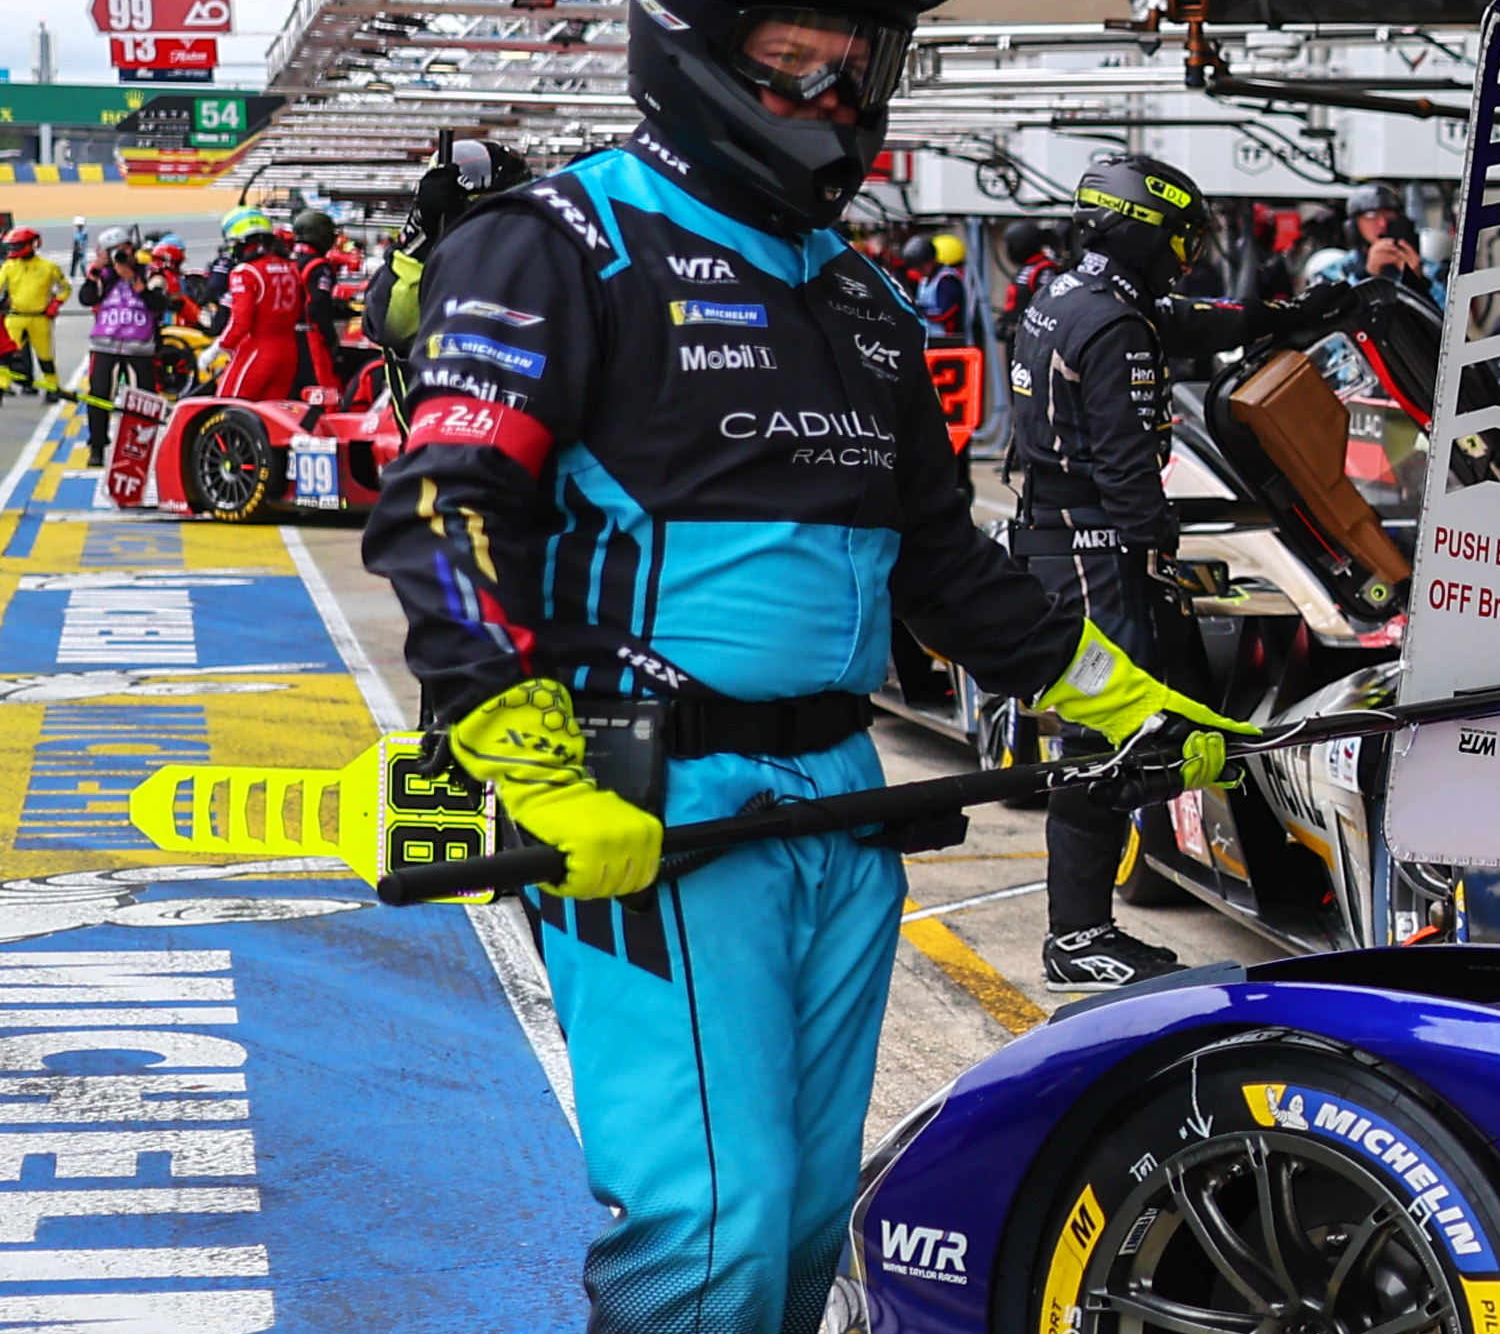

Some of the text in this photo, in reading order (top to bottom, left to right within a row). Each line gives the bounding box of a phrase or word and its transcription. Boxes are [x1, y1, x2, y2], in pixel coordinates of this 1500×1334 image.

[118, 37, 157, 63] 13
[201, 101, 239, 129] 54
[667, 256, 736, 279] WTR
[271, 273, 298, 312] 13
[705, 308, 758, 321] MICHELIN
[461, 341, 533, 369] MICHELIN
[680, 345, 755, 371] Mobil
[126, 394, 162, 416] STOP
[444, 405, 495, 431] 24h
[112, 471, 141, 496] TF
[300, 454, 335, 495] 99
[1434, 527, 1490, 564] PUSH
[1428, 579, 1473, 613] OFF
[617, 646, 689, 690] HRX
[1458, 732, 1497, 757] WTR
[1313, 1102, 1483, 1258] MICHELIN
[1070, 1202, 1097, 1250] M
[881, 1219, 968, 1272] WTR
[882, 1261, 968, 1285] WAYNE TAYLOR RACING
